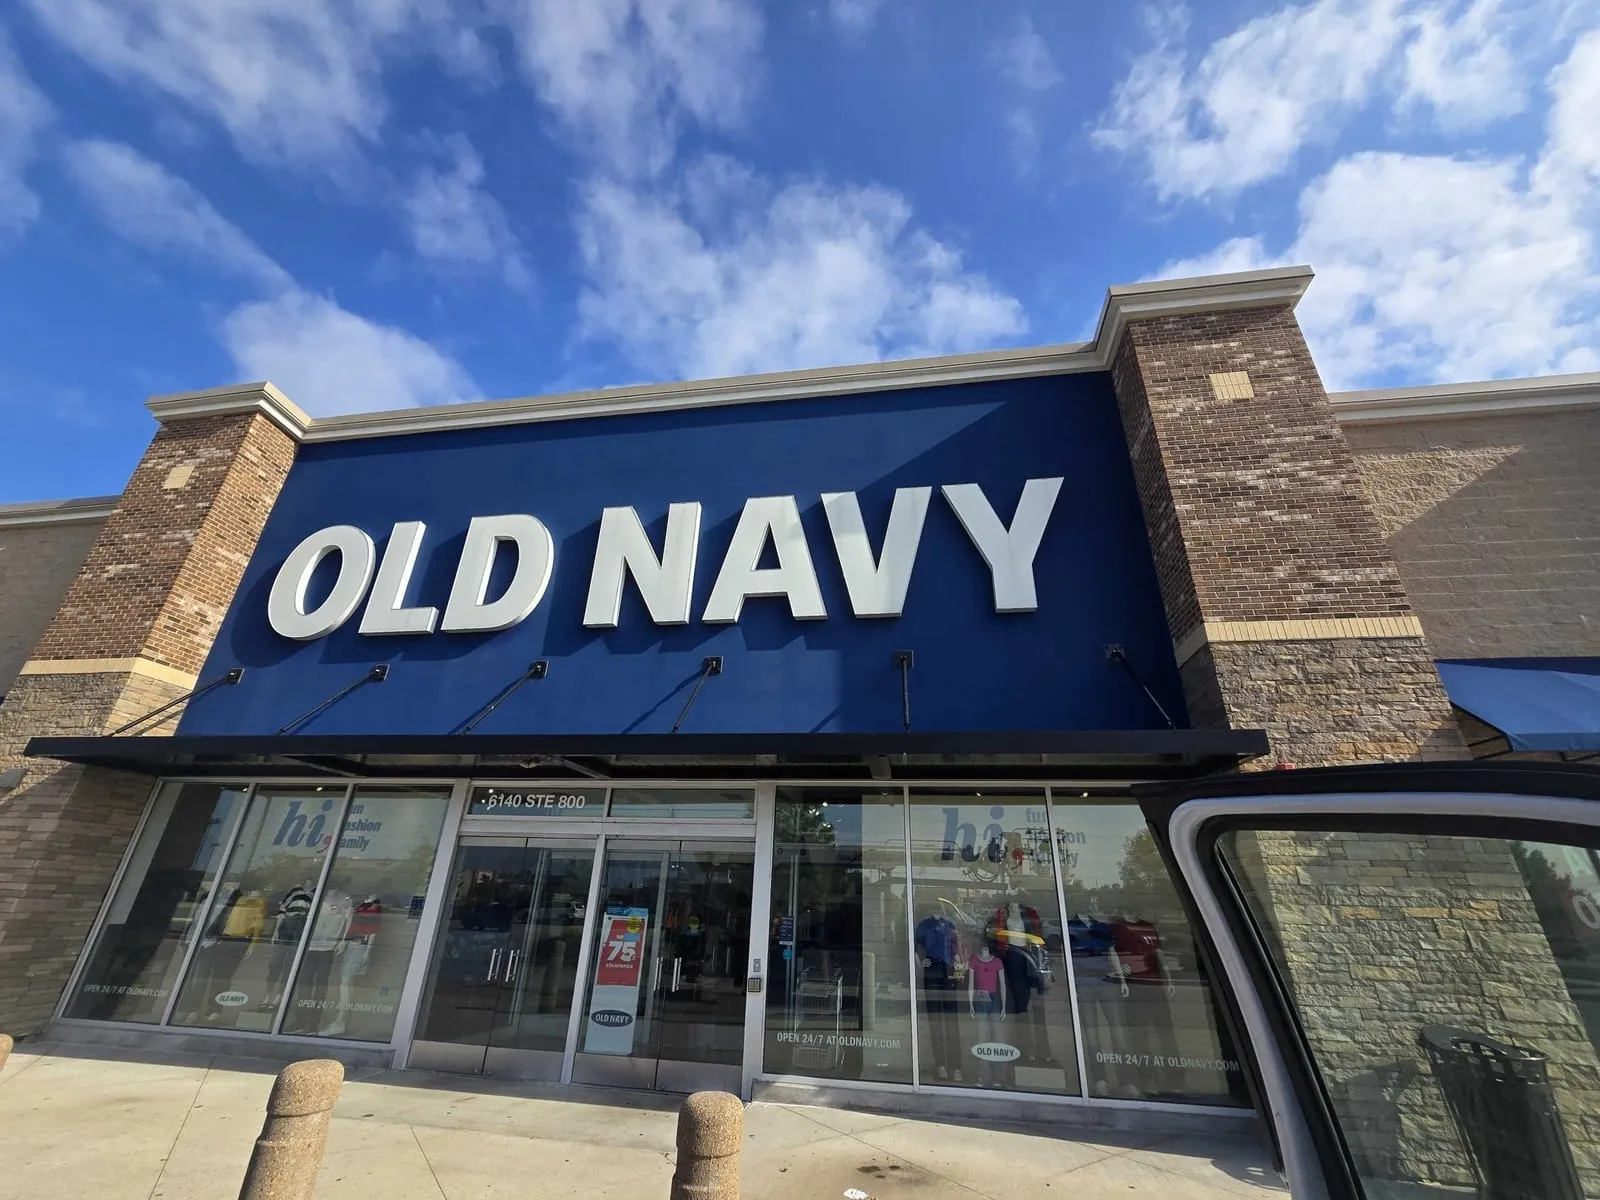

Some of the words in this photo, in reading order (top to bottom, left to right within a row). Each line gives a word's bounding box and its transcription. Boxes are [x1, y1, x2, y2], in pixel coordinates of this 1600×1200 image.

[267, 513, 554, 641] OLD
[583, 476, 1064, 627] NAVY
[488, 794, 522, 808] 6140
[525, 794, 555, 808] STE
[557, 795, 586, 809] 800
[343, 819, 382, 832] ashion
[340, 836, 370, 852] amily
[298, 1000, 316, 1009] OPEN
[595, 1013, 609, 1022] OLD
[610, 1015, 629, 1024] NAVY
[777, 1032, 800, 1043] OPEN
[802, 1033, 823, 1046] 24/7
[826, 1035, 838, 1046] AT
[839, 1036, 900, 1049] OLDNAVY.COM
[977, 1047, 992, 1056] OLD
[993, 1048, 1014, 1057] NAVY
[1096, 1052, 1122, 1064] OPEN
[1125, 1054, 1149, 1067] 24/7
[1153, 1055, 1166, 1067] AT
[1167, 1057, 1240, 1071] OLDNAVY.COM
